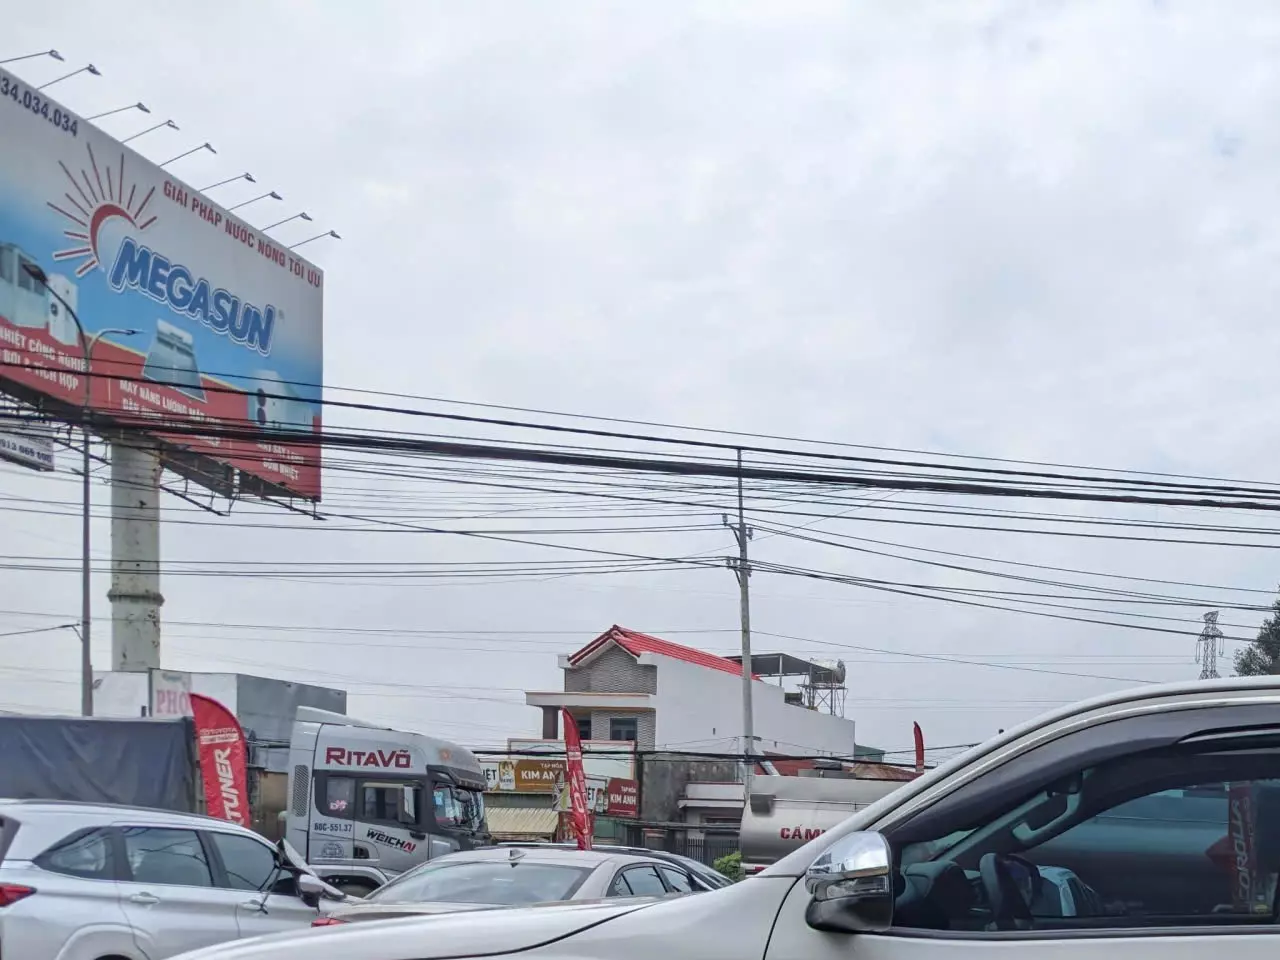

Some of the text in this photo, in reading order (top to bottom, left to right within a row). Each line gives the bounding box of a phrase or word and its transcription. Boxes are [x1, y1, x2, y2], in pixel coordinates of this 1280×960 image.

[109, 235, 275, 357] MEGASUN
[521, 770, 540, 780] KIM
[542, 770, 557, 780] AN
[366, 829, 417, 853] WEICHAI
